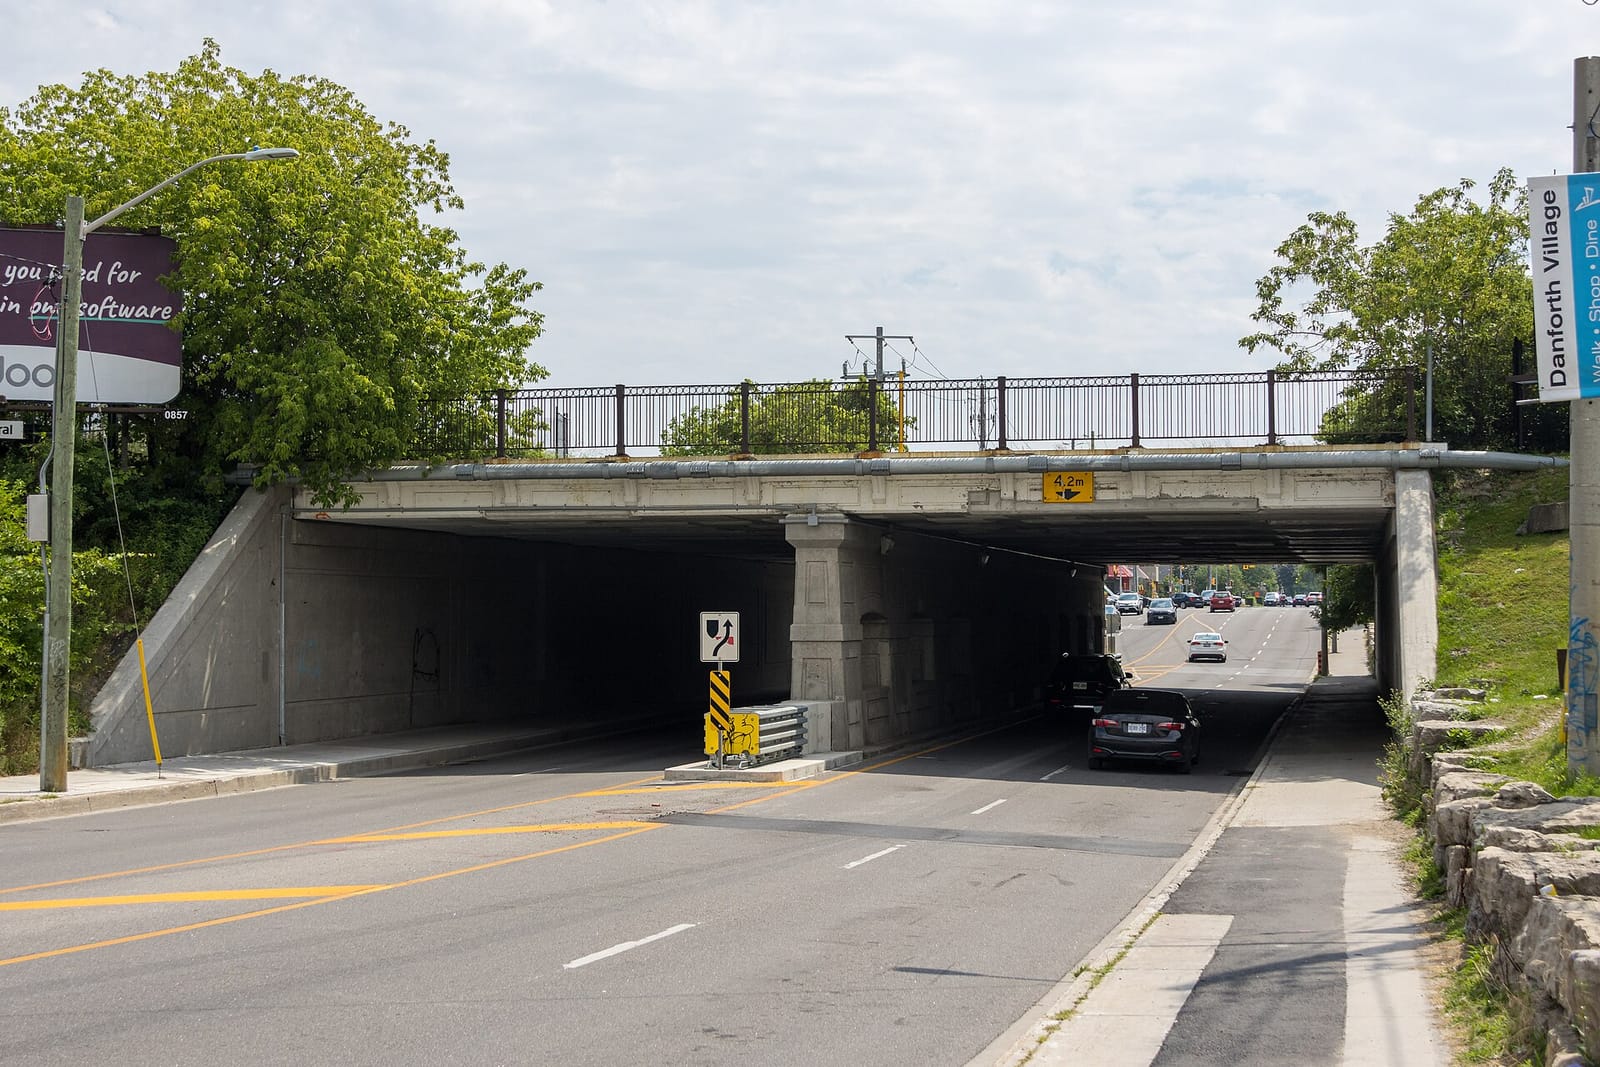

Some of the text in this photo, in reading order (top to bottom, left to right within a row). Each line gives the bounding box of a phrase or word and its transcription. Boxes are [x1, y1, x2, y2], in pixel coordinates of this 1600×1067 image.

[1585, 219, 1599, 258] Dine
[2, 265, 41, 287] you
[107, 261, 142, 285] for
[1542, 190, 1567, 387] Danforth Village
[0, 295, 20, 314] in
[79, 295, 173, 320] software
[164, 410, 188, 420] 0857
[1053, 474, 1084, 487] 4.2m
